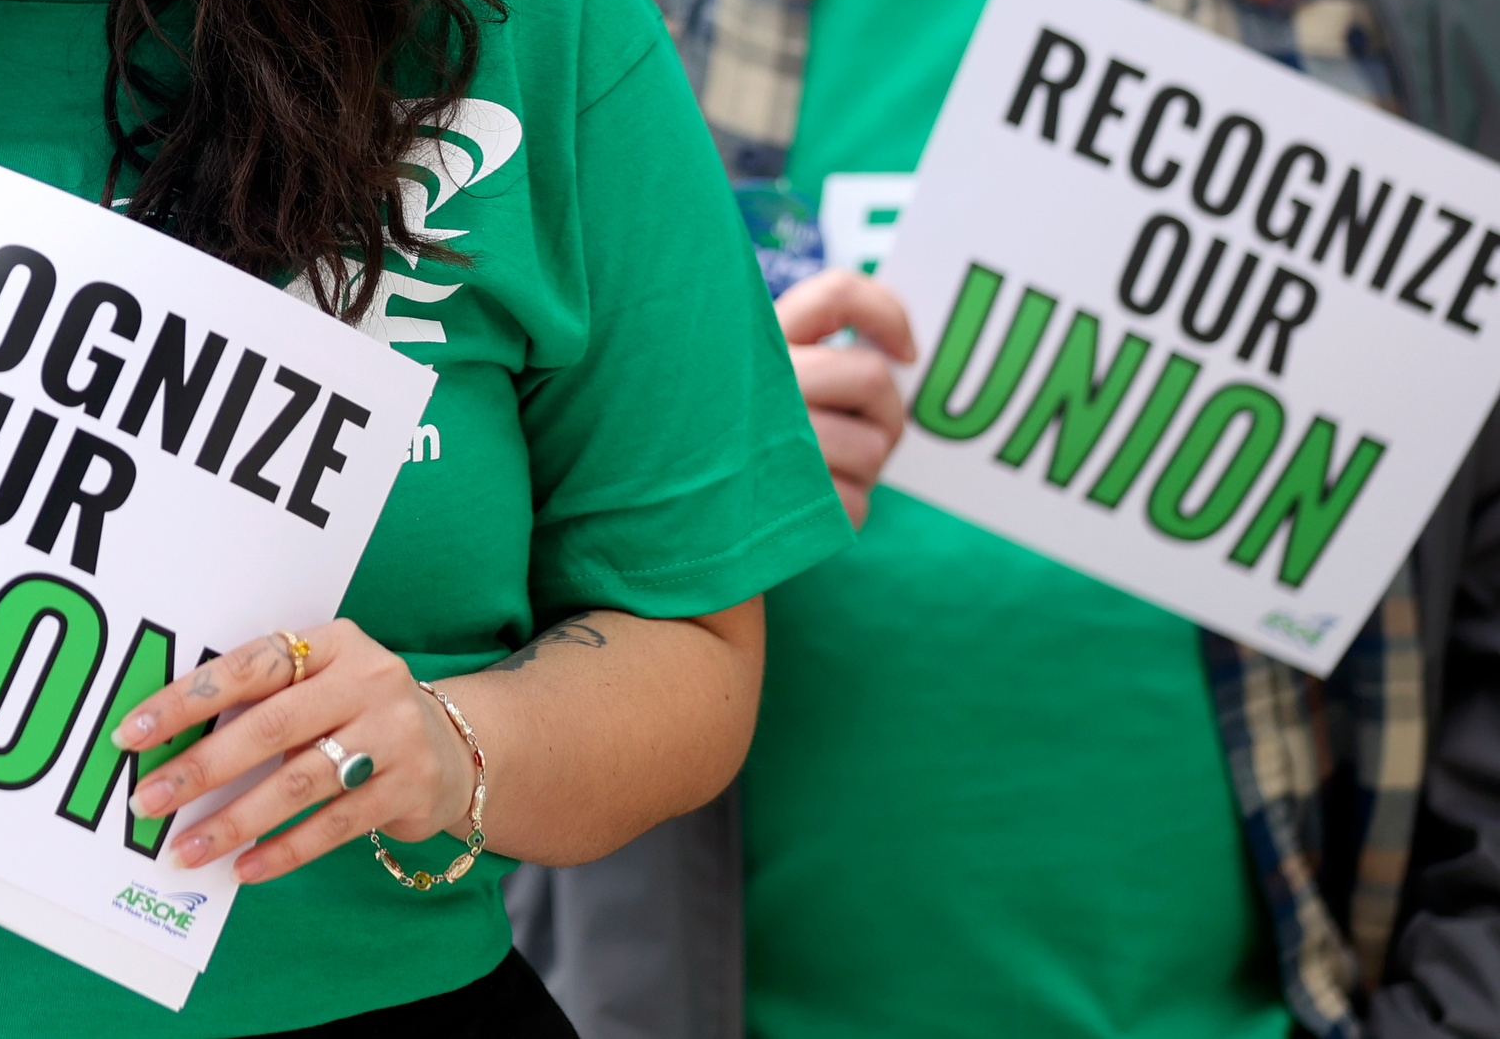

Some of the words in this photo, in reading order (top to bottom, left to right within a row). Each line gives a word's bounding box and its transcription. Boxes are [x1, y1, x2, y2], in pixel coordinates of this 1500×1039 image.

[1003, 25, 1500, 337] RECOGNIZE
[1116, 211, 1321, 379] OUR
[907, 261, 1388, 592] UNION
[116, 886, 197, 932] AFSCME
